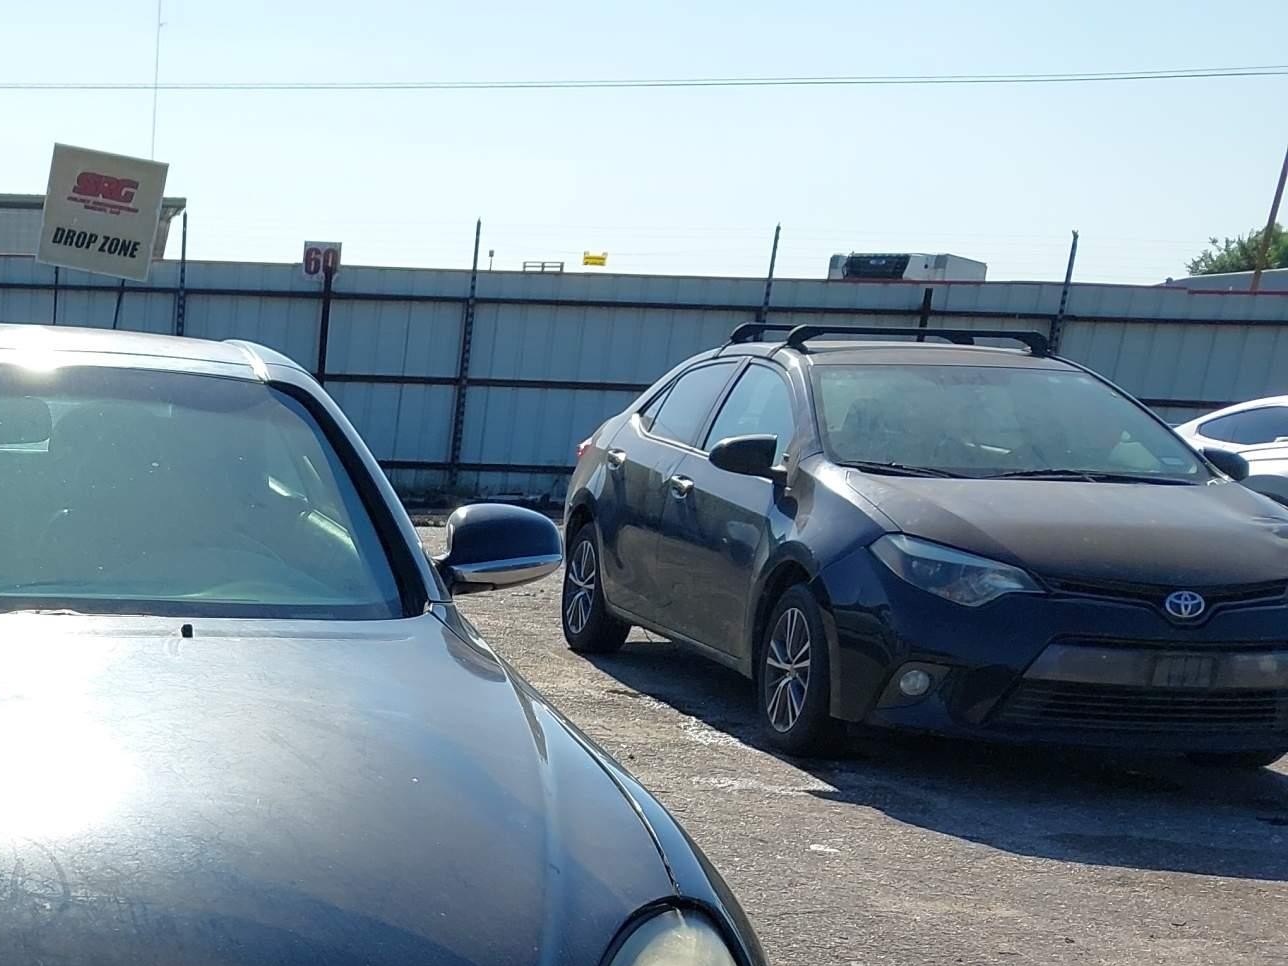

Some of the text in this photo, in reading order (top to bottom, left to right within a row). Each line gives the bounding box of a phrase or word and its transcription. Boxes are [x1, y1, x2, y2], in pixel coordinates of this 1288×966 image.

[52, 226, 140, 259] DROP ZONE
[304, 246, 339, 274] 60
